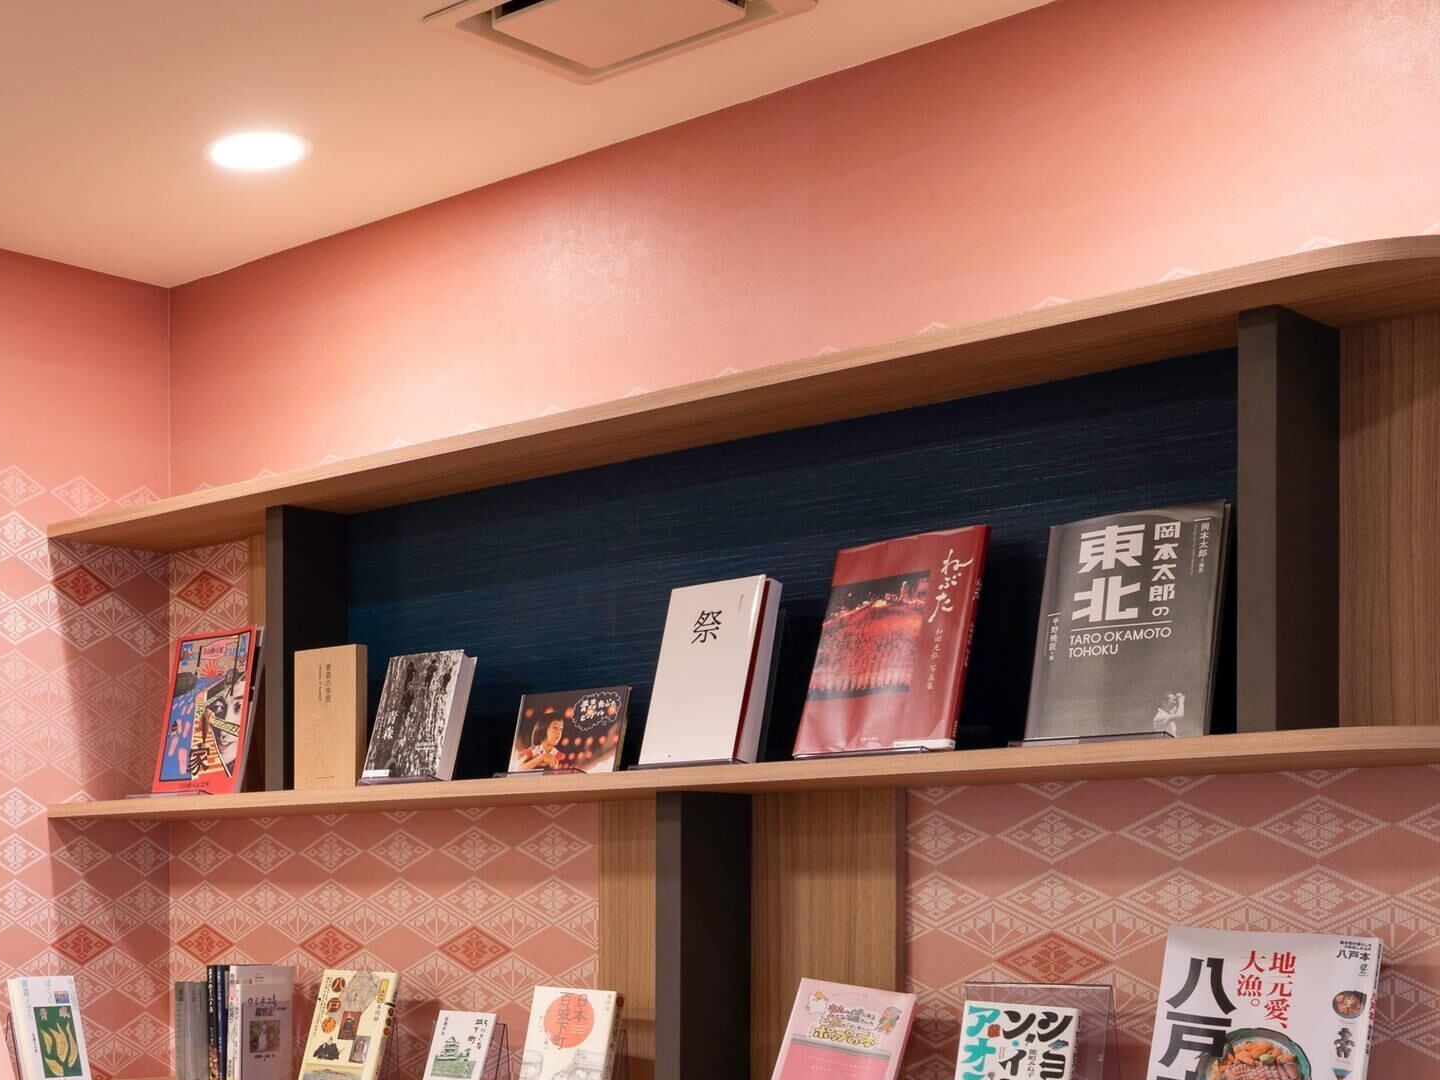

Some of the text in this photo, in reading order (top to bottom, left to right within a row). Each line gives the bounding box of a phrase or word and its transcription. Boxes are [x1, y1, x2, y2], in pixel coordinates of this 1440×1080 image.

[1071, 524, 1146, 623] 東北
[1149, 521, 1182, 617] 岡本太郎の
[691, 610, 723, 644] 祭
[1069, 626, 1172, 646] TARO OKAMOTO
[1068, 644, 1119, 658] TOHOKU
[186, 743, 211, 777] 家
[1336, 950, 1370, 961] 八戸本
[1236, 950, 1265, 1007] 大漁。
[1264, 951, 1297, 1029] 地元愛、
